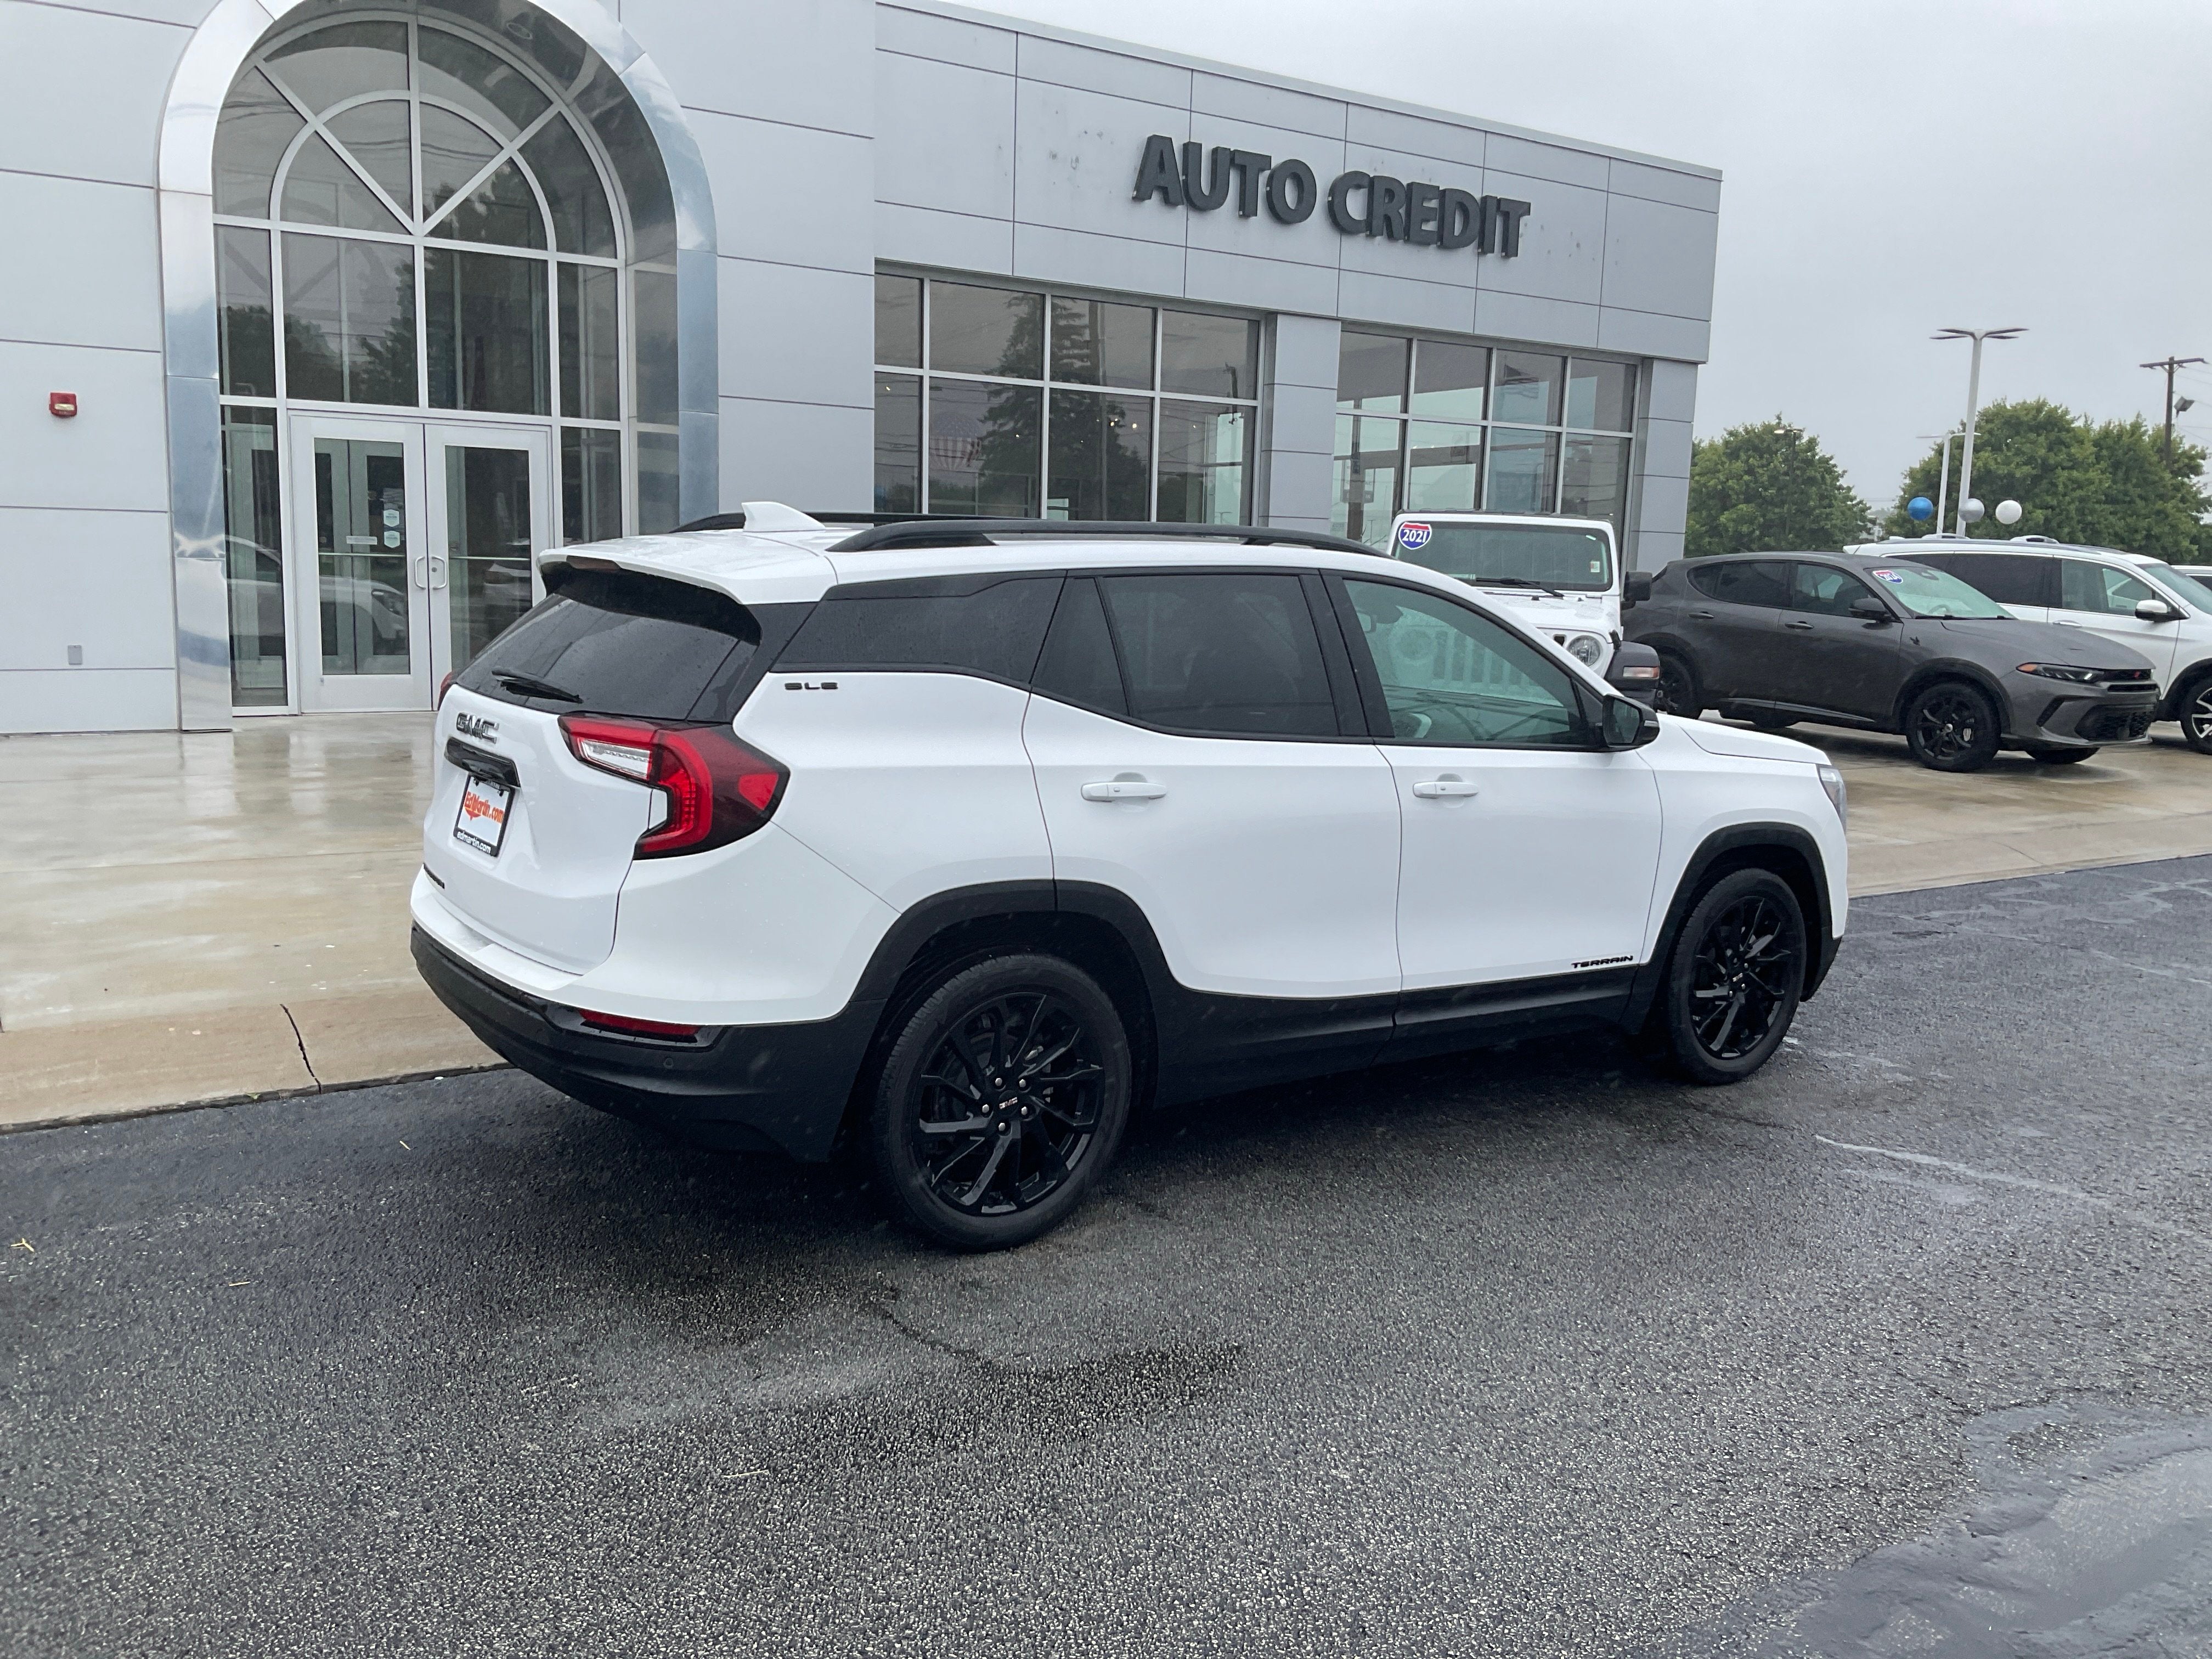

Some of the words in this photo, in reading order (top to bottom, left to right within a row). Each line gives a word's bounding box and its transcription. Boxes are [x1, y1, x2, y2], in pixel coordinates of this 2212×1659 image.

[1132, 135, 1317, 224] AUTO
[1328, 171, 1531, 258] CREDIT
[1402, 529, 1427, 543] 2021
[456, 713, 500, 744] GMC
[457, 830, 491, 854] edmartin.com
[1571, 956, 1633, 968] TERRAIN
